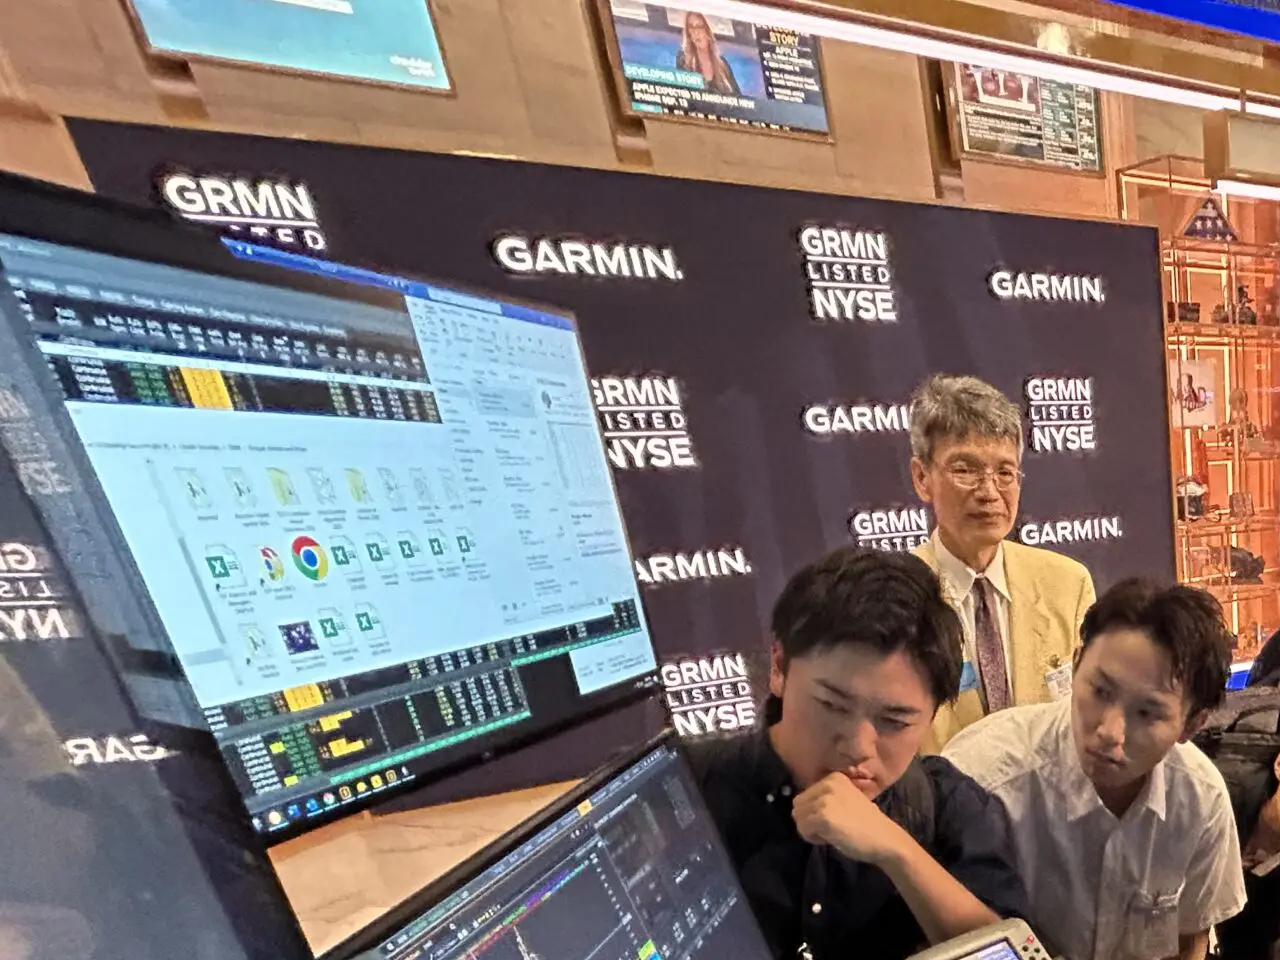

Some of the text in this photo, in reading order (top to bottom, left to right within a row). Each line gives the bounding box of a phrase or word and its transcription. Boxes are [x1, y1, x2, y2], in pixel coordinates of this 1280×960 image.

[165, 175, 315, 220] GRMN
[801, 227, 887, 260] GRMN
[807, 262, 891, 283] LISTED
[812, 288, 898, 321] NYSE
[1027, 378, 1091, 400] GRMN
[604, 412, 686, 429] ISTED
[805, 405, 912, 432] GARMI
[1031, 405, 1093, 420] LISTED
[1033, 425, 1096, 451] NYSE
[607, 437, 696, 468] NYSE
[853, 509, 928, 534] GRMN
[635, 547, 752, 582] ARMIN.
[661, 652, 747, 687] GRMN
[666, 682, 751, 707] LISTED
[673, 701, 756, 737] NYSE
